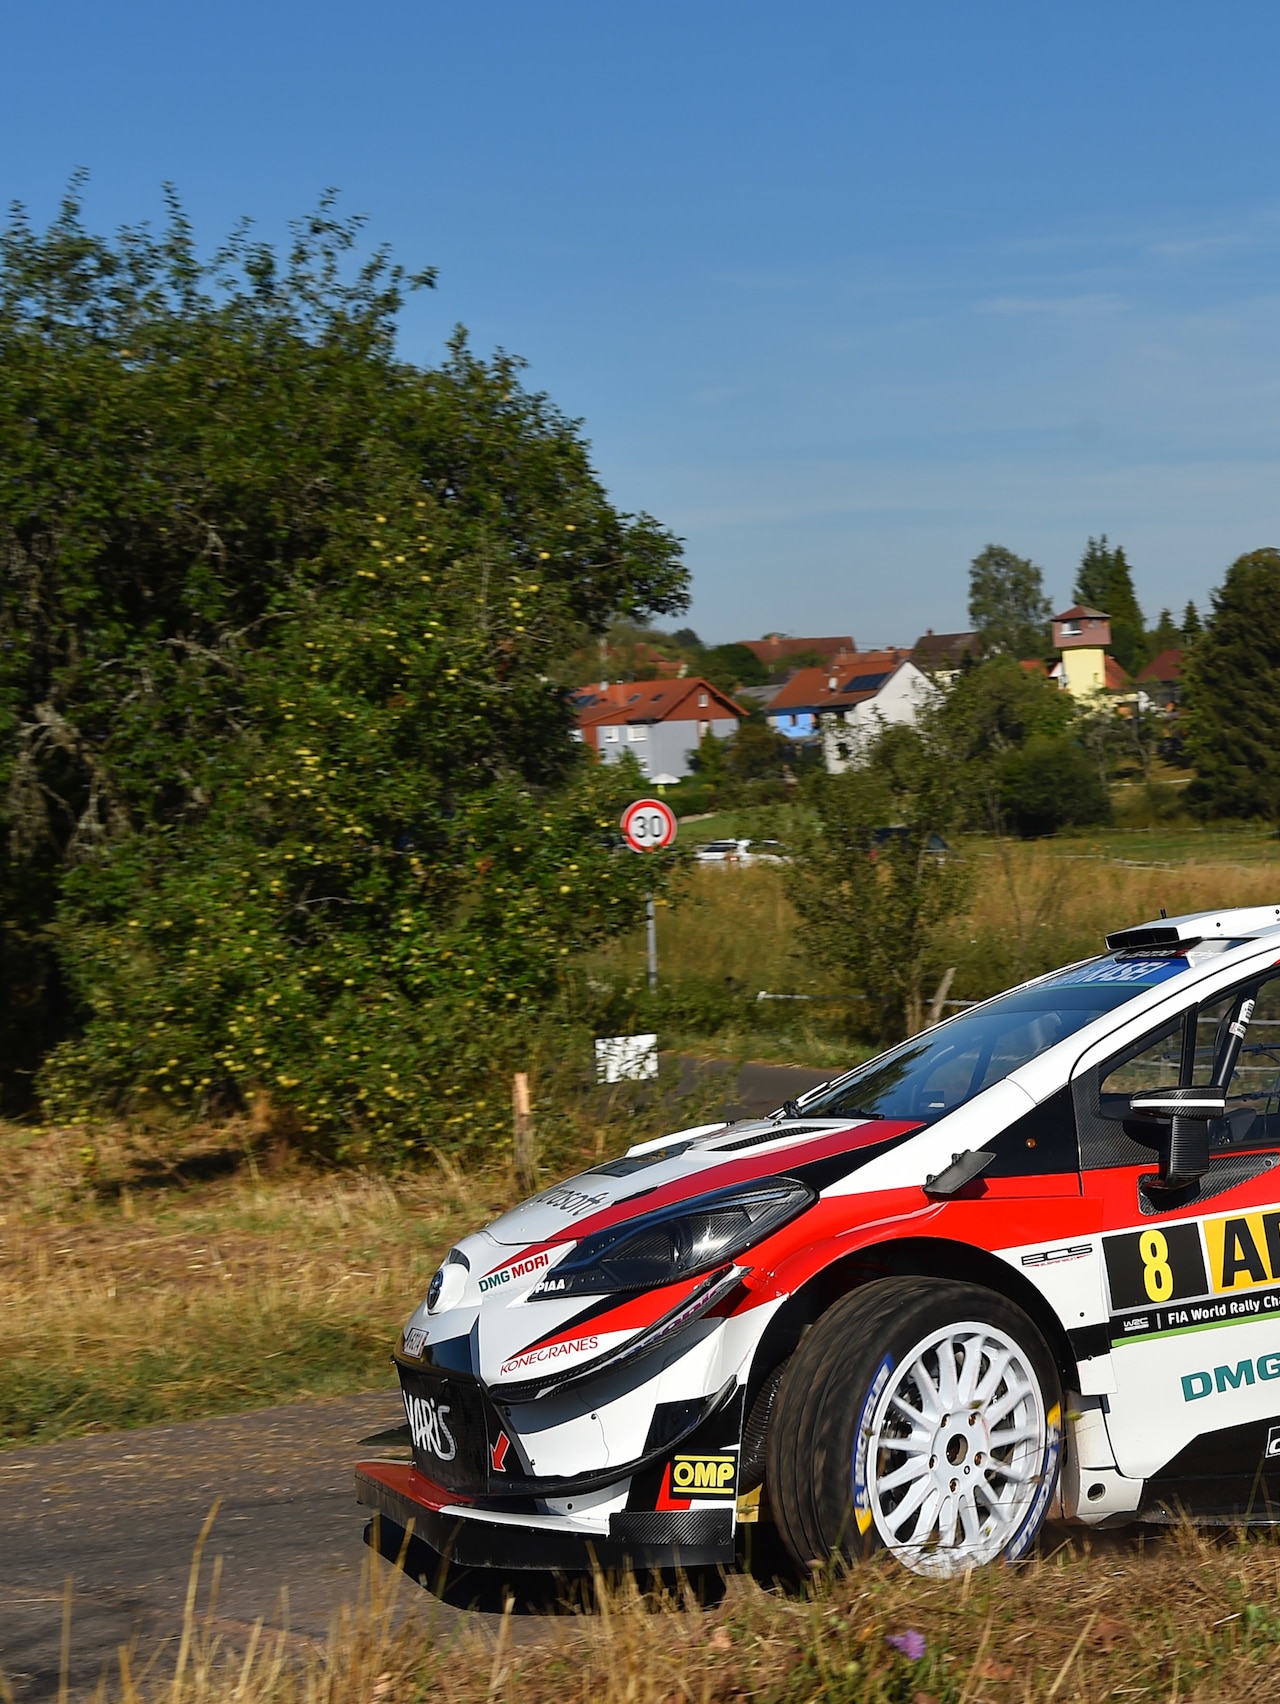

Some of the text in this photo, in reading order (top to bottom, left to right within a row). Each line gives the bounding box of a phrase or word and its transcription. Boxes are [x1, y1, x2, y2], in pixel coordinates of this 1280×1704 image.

[634, 815, 662, 838] 30
[478, 1253, 549, 1294] DMG MORI
[1139, 1229, 1174, 1303] 8
[535, 1278, 566, 1294] PIAA
[1168, 1310, 1188, 1325] FIA
[1191, 1303, 1226, 1320] World
[1231, 1297, 1260, 1314] Rally
[500, 1337, 599, 1376] KONECRANES
[673, 1462, 735, 1488] OMP
